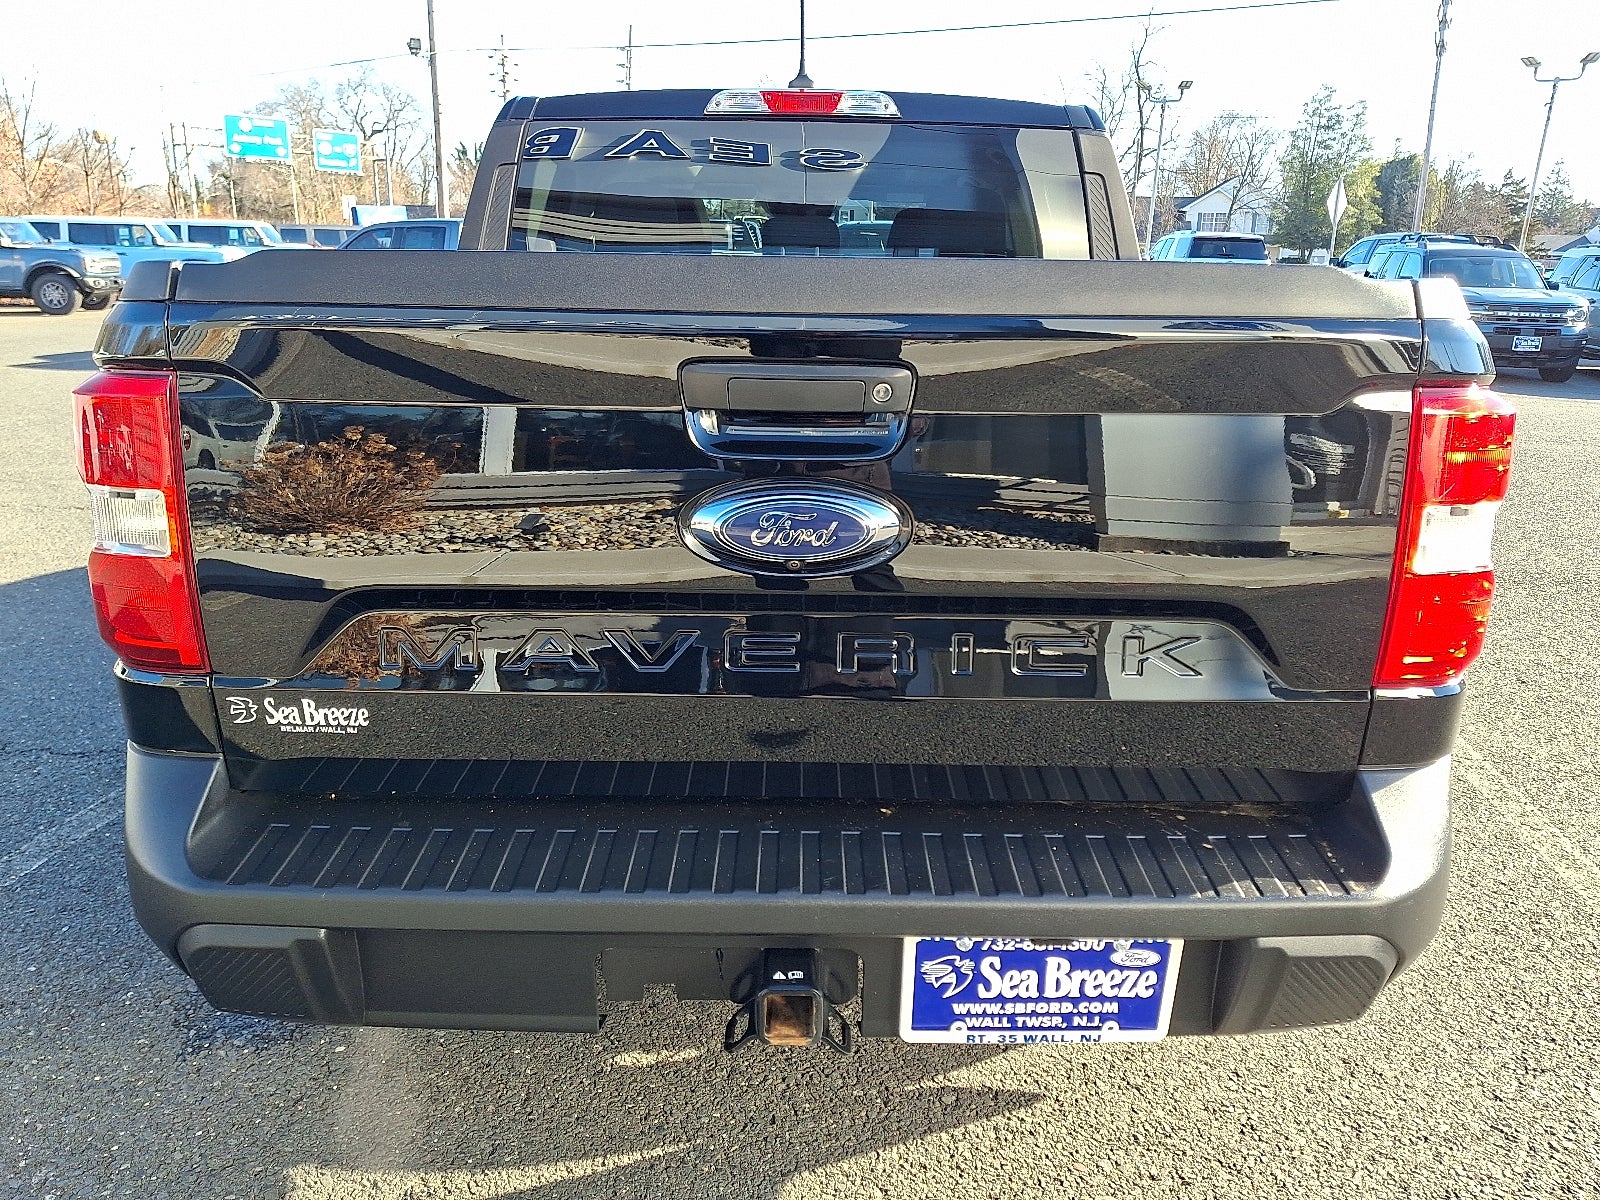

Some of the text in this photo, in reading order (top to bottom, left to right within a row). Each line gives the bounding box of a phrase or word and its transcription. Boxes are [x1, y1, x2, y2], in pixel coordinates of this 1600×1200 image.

[750, 511, 839, 547] Ford
[379, 626, 1203, 678] MAVERICK
[264, 697, 370, 726] Sea Breeze
[280, 725, 314, 733] BELMAR
[1120, 952, 1150, 964] Ford
[978, 956, 1158, 999] Sea Breeze
[952, 1002, 1119, 1014] WWW.SBFORD.COM
[966, 1017, 1011, 1028] WALL
[1073, 1016, 1102, 1027] N.J.
[966, 1035, 1102, 1043] RT. 35 WALL, NJ
